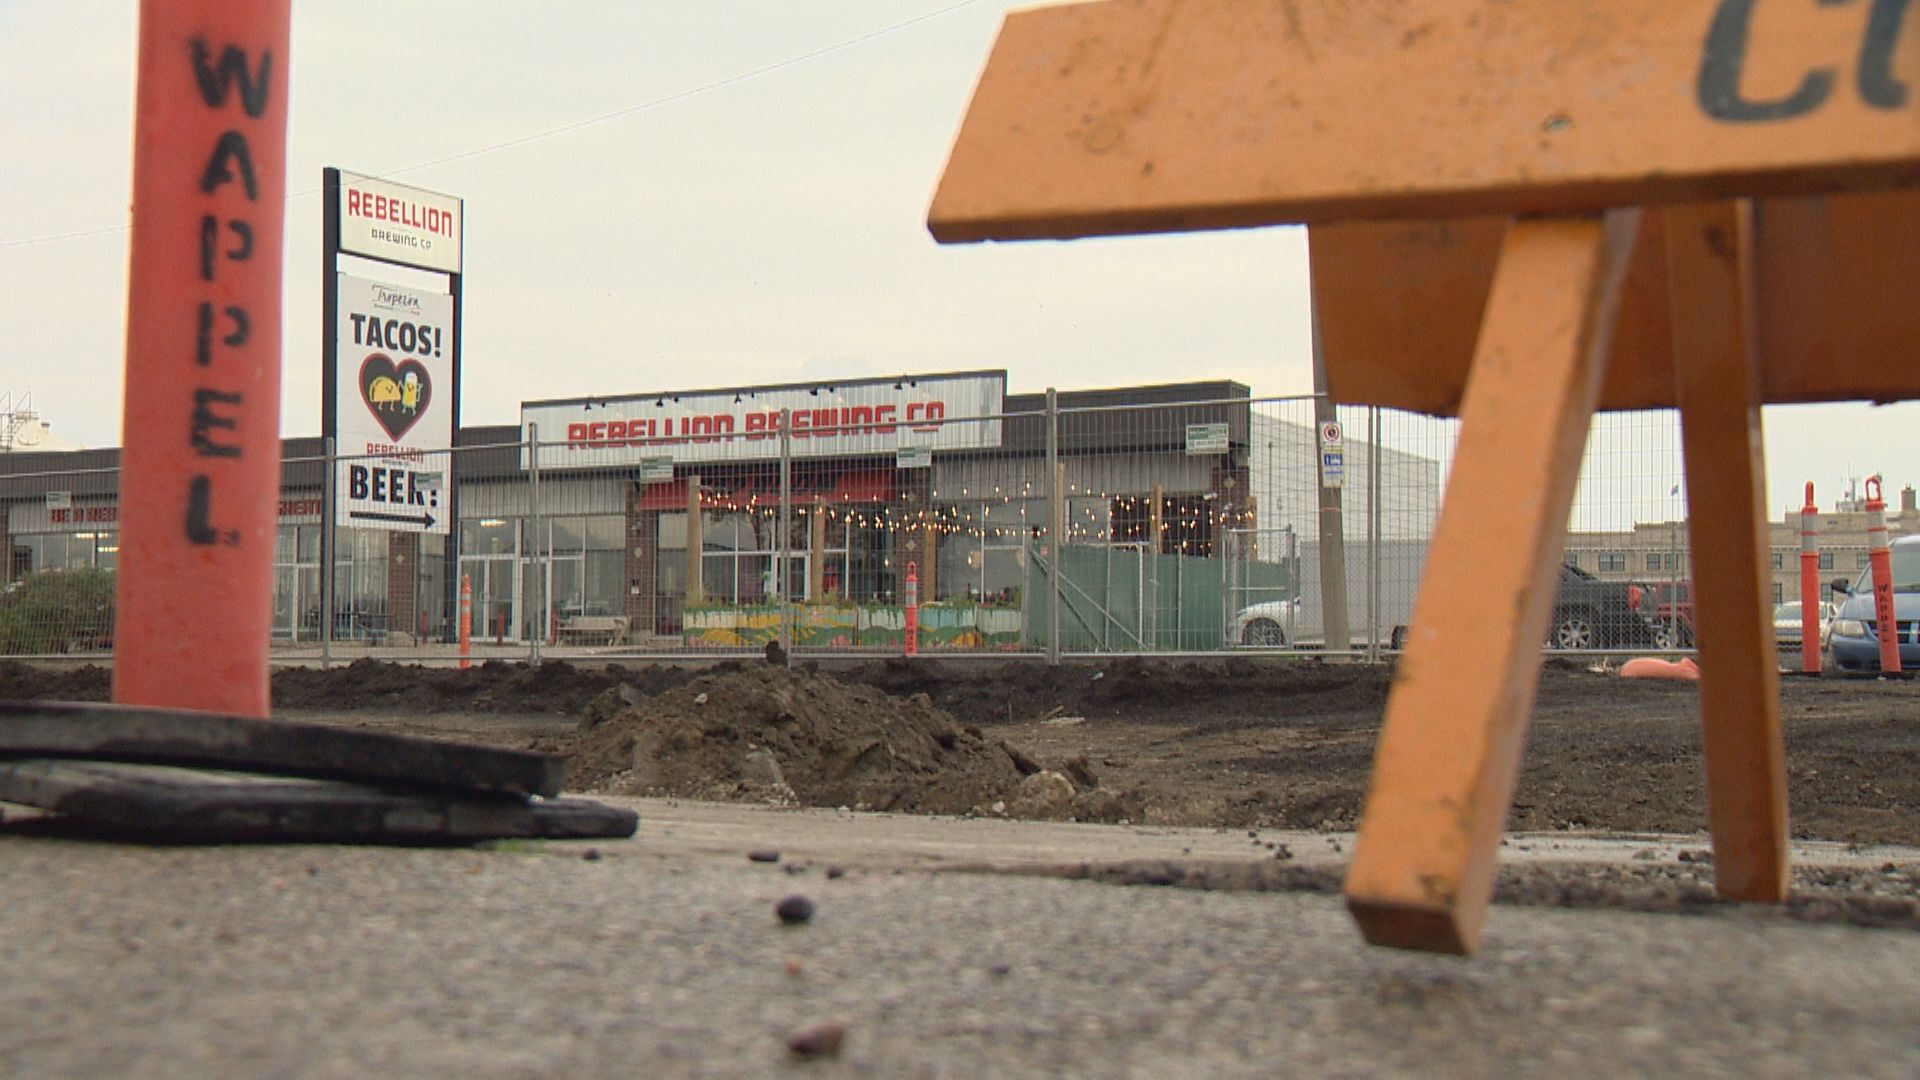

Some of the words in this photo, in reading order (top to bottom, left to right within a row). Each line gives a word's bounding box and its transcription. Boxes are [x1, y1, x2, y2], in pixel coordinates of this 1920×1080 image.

[348, 189, 452, 238] REBELLION
[371, 228, 418, 248] BREWING
[185, 35, 273, 546] WAPPEL
[350, 313, 441, 358] TACOS!
[568, 414, 735, 449] REBELLION
[907, 401, 944, 427] CO
